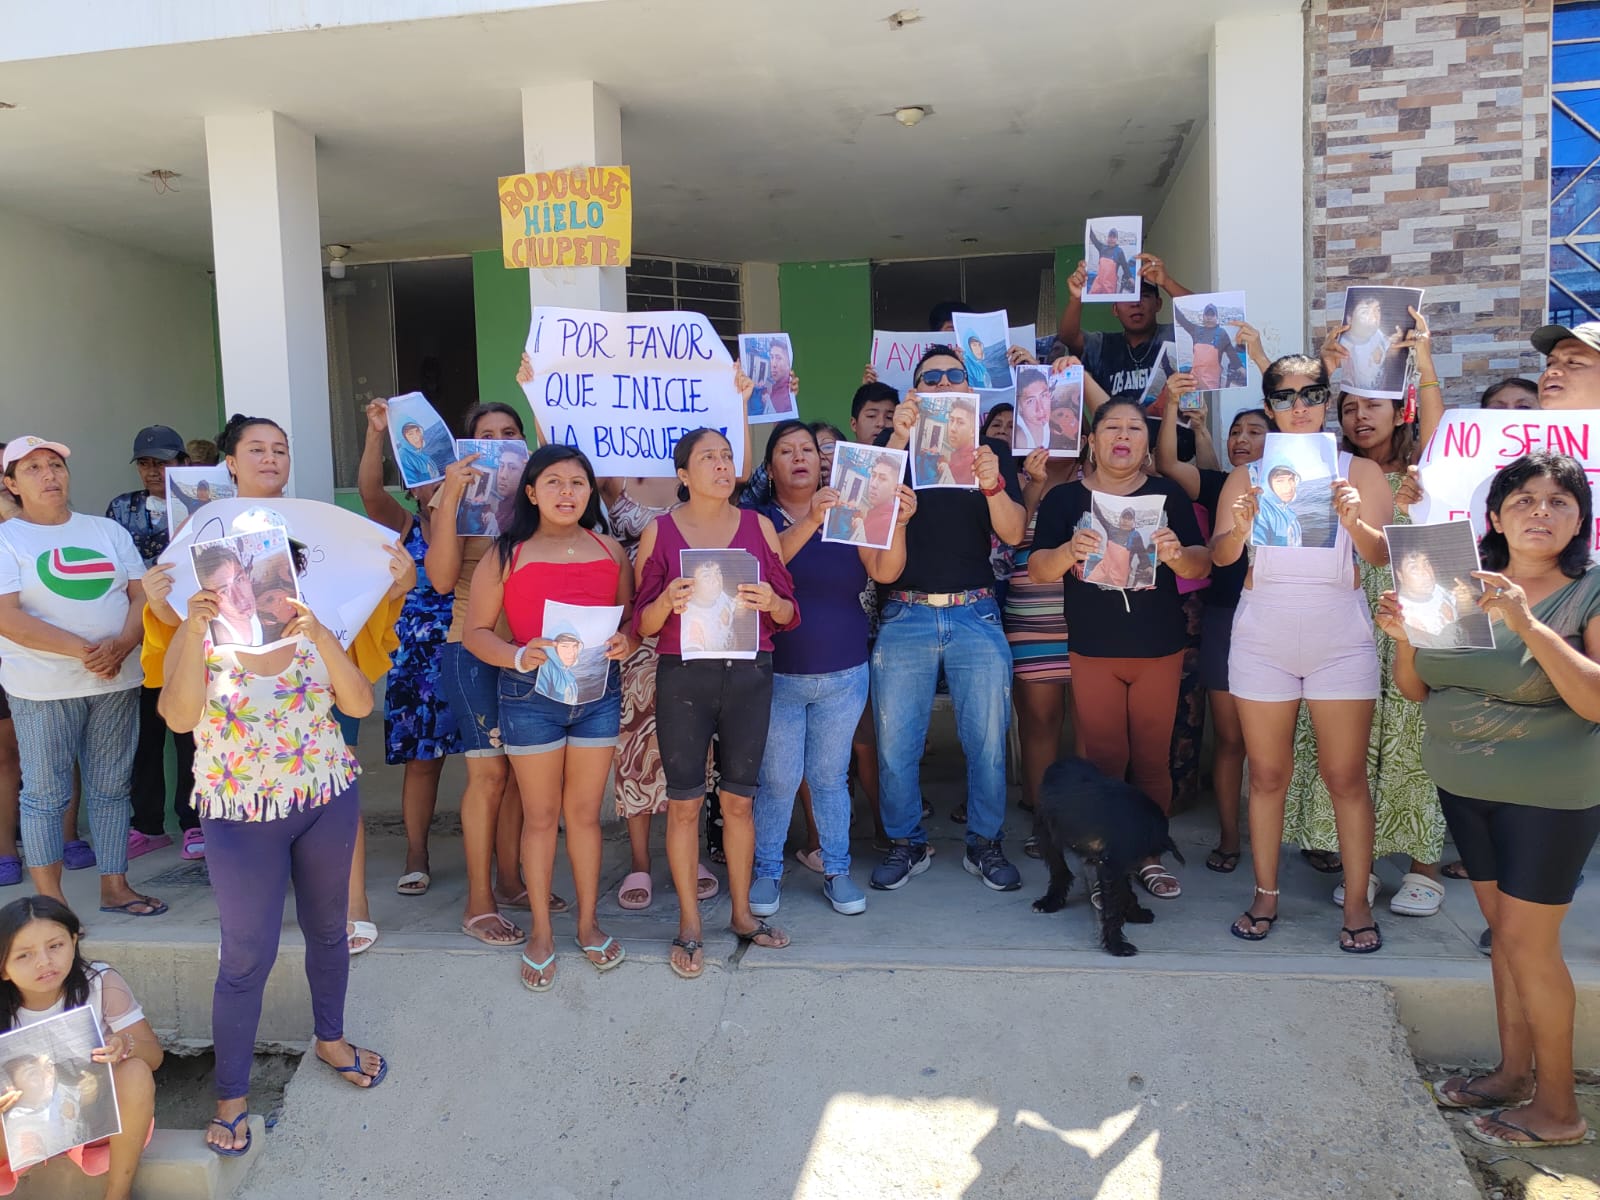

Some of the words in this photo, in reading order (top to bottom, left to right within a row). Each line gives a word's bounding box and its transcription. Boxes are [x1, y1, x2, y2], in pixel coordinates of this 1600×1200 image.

[511, 236, 620, 267] CHUPETE
[626, 323, 712, 361] FAVOR
[545, 372, 597, 410] QUE
[612, 374, 709, 413] INICIE
[1498, 423, 1590, 461] SEAN
